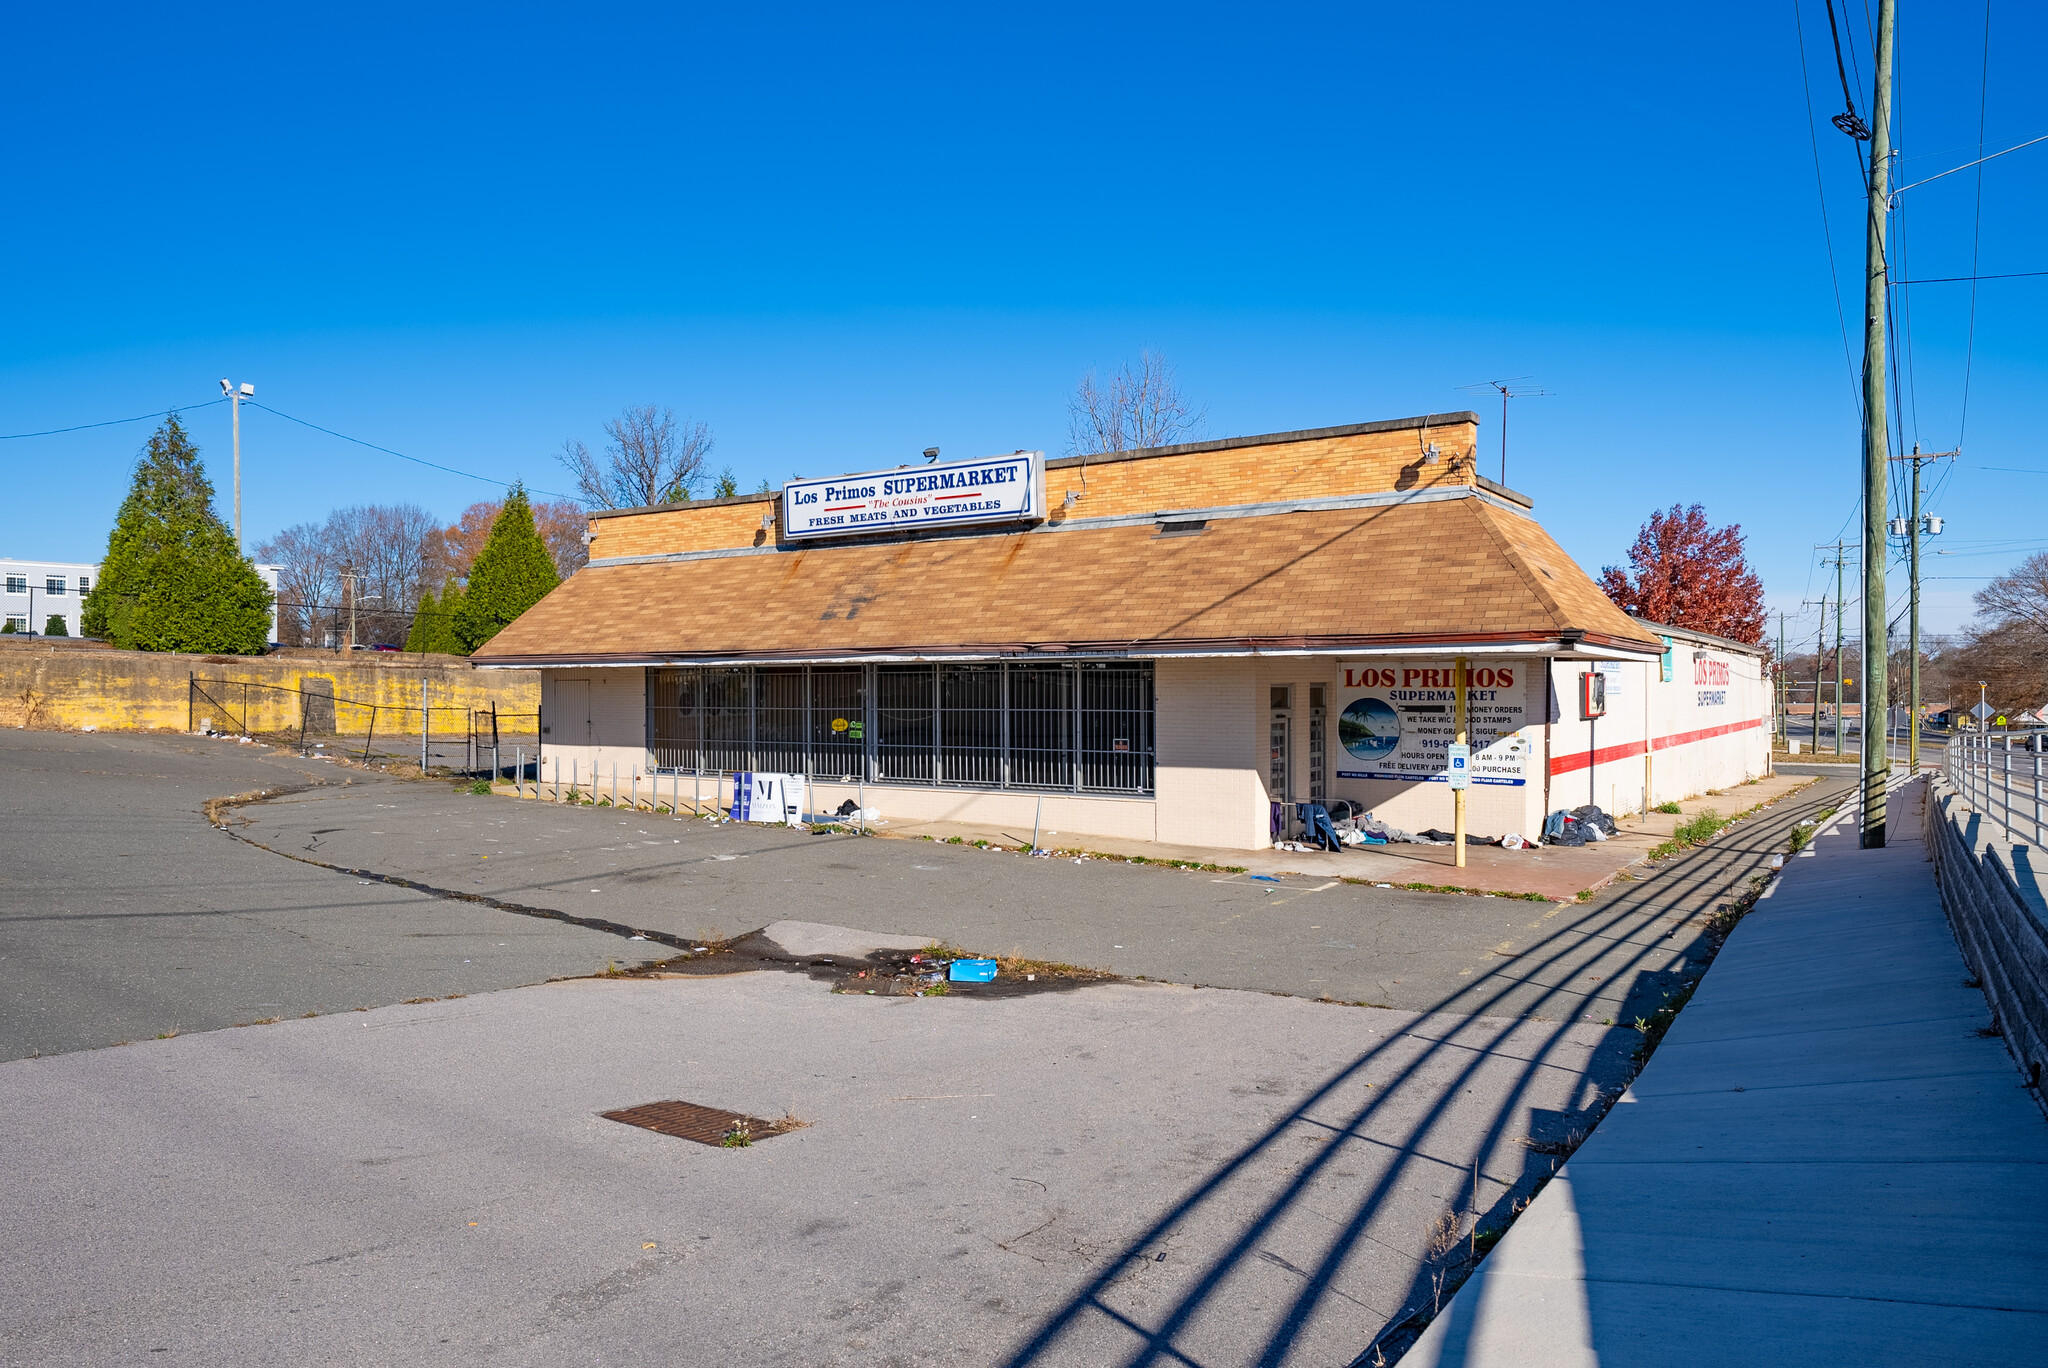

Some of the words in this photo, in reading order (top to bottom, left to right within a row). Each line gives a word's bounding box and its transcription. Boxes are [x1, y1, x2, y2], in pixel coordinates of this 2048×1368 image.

[795, 490, 818, 506] Los
[825, 484, 876, 502] Primos
[884, 465, 1018, 496] SUPERMARKET
[809, 514, 844, 527] FRESH
[850, 511, 887, 524] MEATS
[893, 508, 918, 519] AND
[924, 500, 1001, 516] VEGETABLES
[1344, 668, 1396, 688] LOS
[1694, 660, 1707, 685] LOS
[1708, 661, 1730, 686] PRIMOS
[1390, 690, 1497, 701] SUPERMAKET
[1698, 690, 1726, 706] SUPERMARKET
